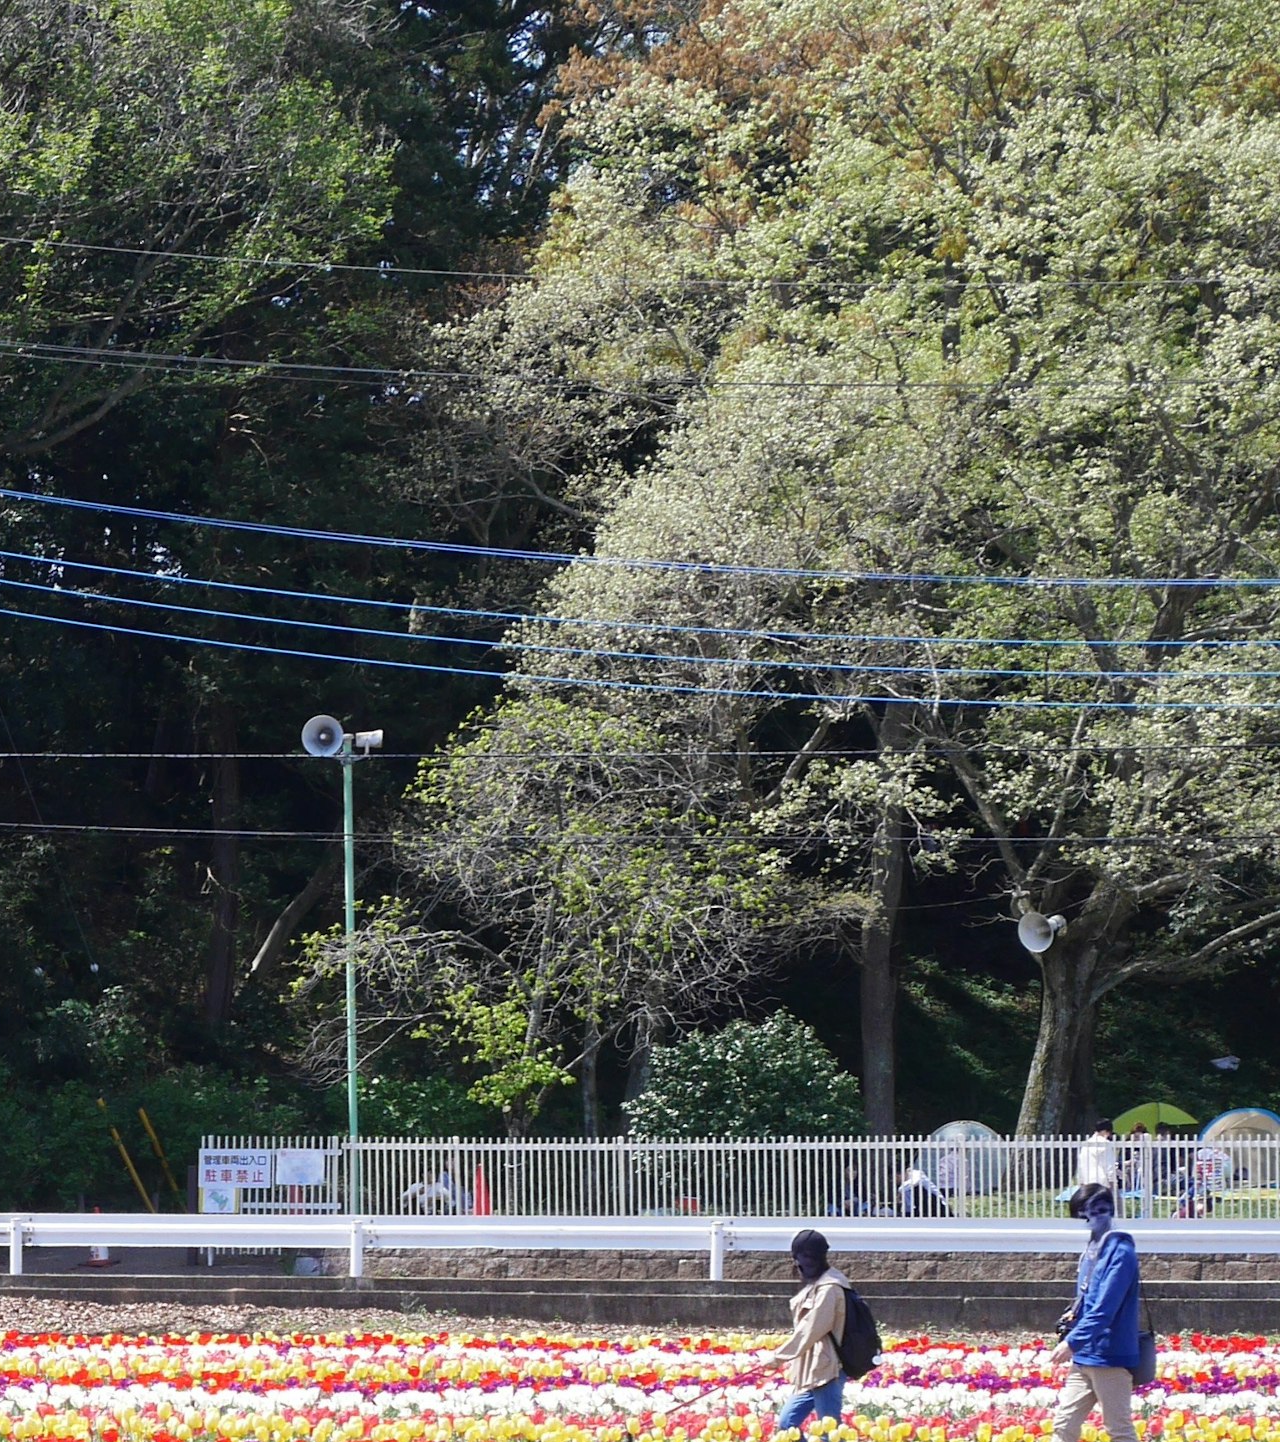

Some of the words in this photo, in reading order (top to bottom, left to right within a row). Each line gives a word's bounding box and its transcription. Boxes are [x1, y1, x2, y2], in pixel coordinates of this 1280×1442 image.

[204, 1155, 267, 1166] 管理車両出入口
[204, 1169, 264, 1183] 駐車禁止
